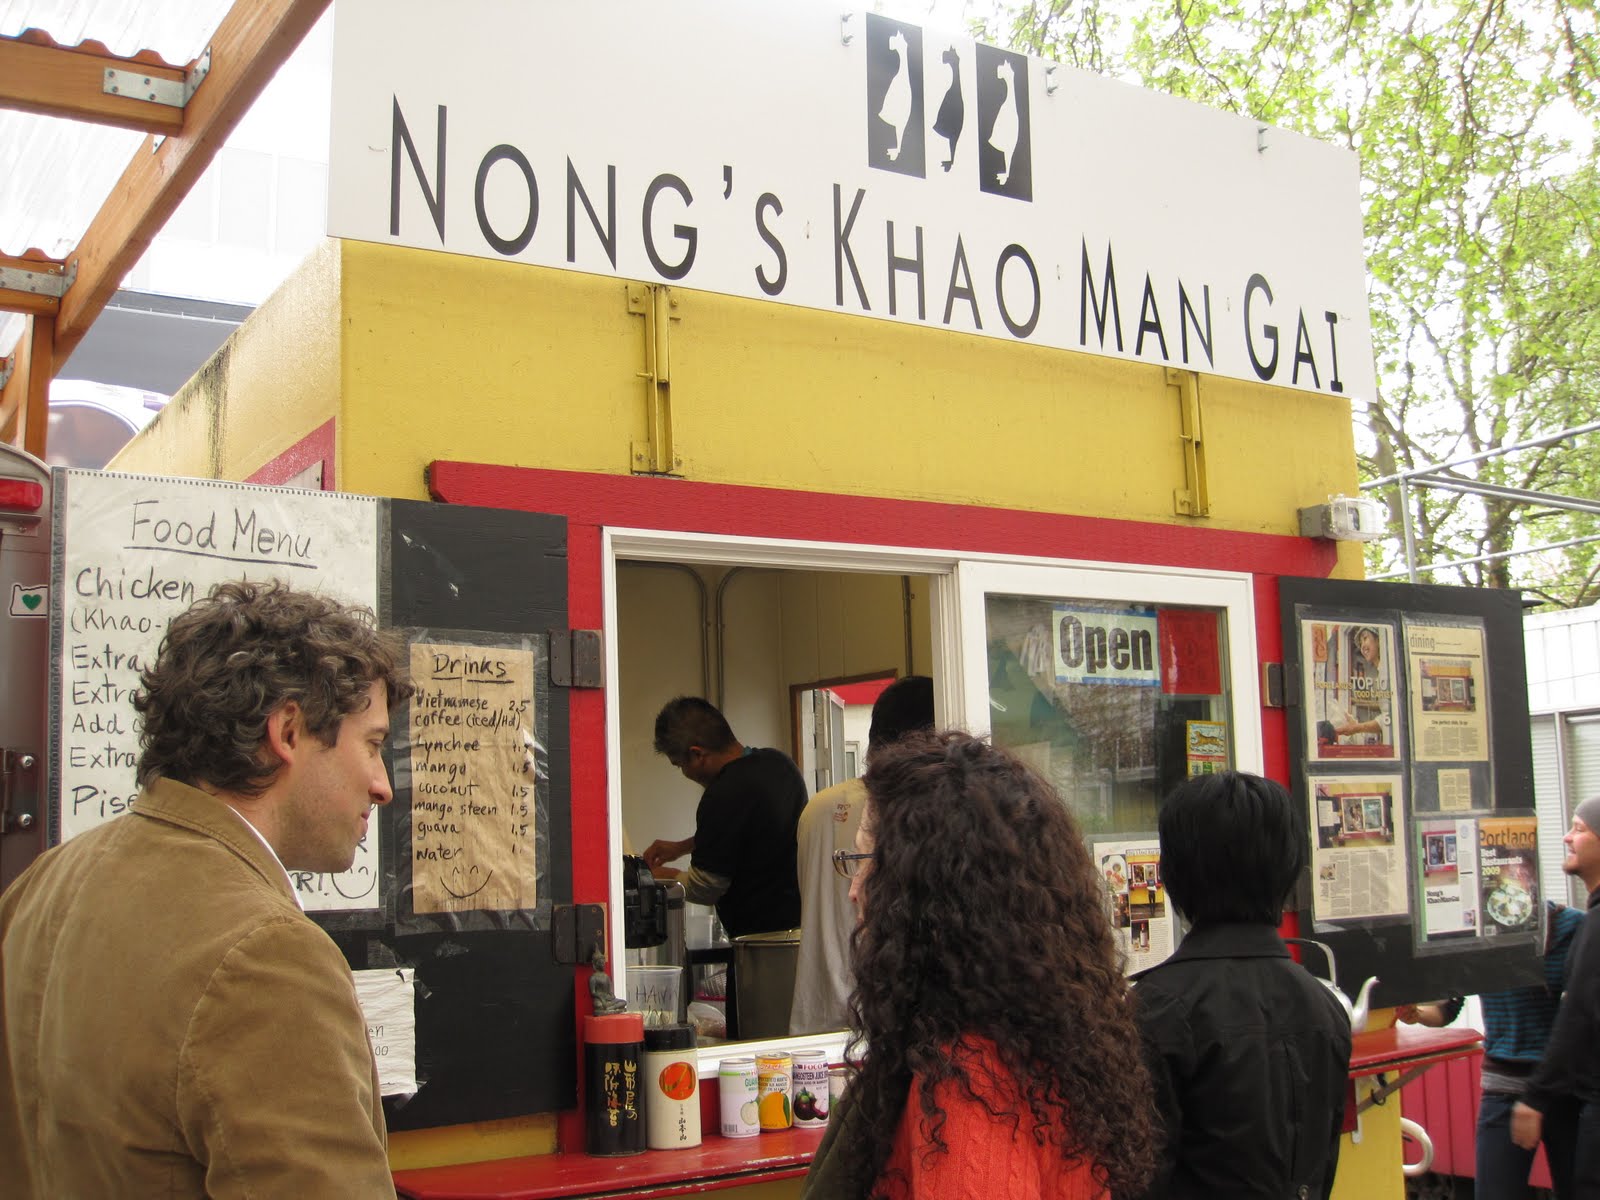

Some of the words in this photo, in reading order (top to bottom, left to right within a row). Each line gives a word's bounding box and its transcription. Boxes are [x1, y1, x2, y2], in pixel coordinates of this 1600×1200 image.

[389, 92, 788, 296] NONG'S
[833, 183, 1041, 338] KHAO
[1080, 232, 1213, 370] MAN
[1243, 273, 1343, 392] GAI
[131, 498, 216, 548] Food
[232, 508, 311, 559] Menu
[75, 566, 195, 602] Chicken
[71, 607, 171, 633] (Khao-
[1060, 615, 1153, 674] Open
[1410, 634, 1436, 651] dining
[71, 643, 143, 672] Extra
[432, 653, 507, 678] Drinks
[1351, 676, 1374, 691] TOP
[1376, 678, 1388, 691] 10
[416, 687, 488, 710] Vietnamese
[72, 713, 125, 734] Add
[415, 708, 461, 727] coffee
[70, 742, 137, 768] Extra
[512, 761, 530, 773] 1.5
[419, 780, 480, 796] coconut
[512, 784, 530, 797] 1.5
[510, 803, 528, 817] 1.5
[417, 821, 460, 840] guava
[511, 824, 528, 836] 1.5
[1480, 827, 1537, 846] Portland
[1482, 866, 1500, 876] 2009
